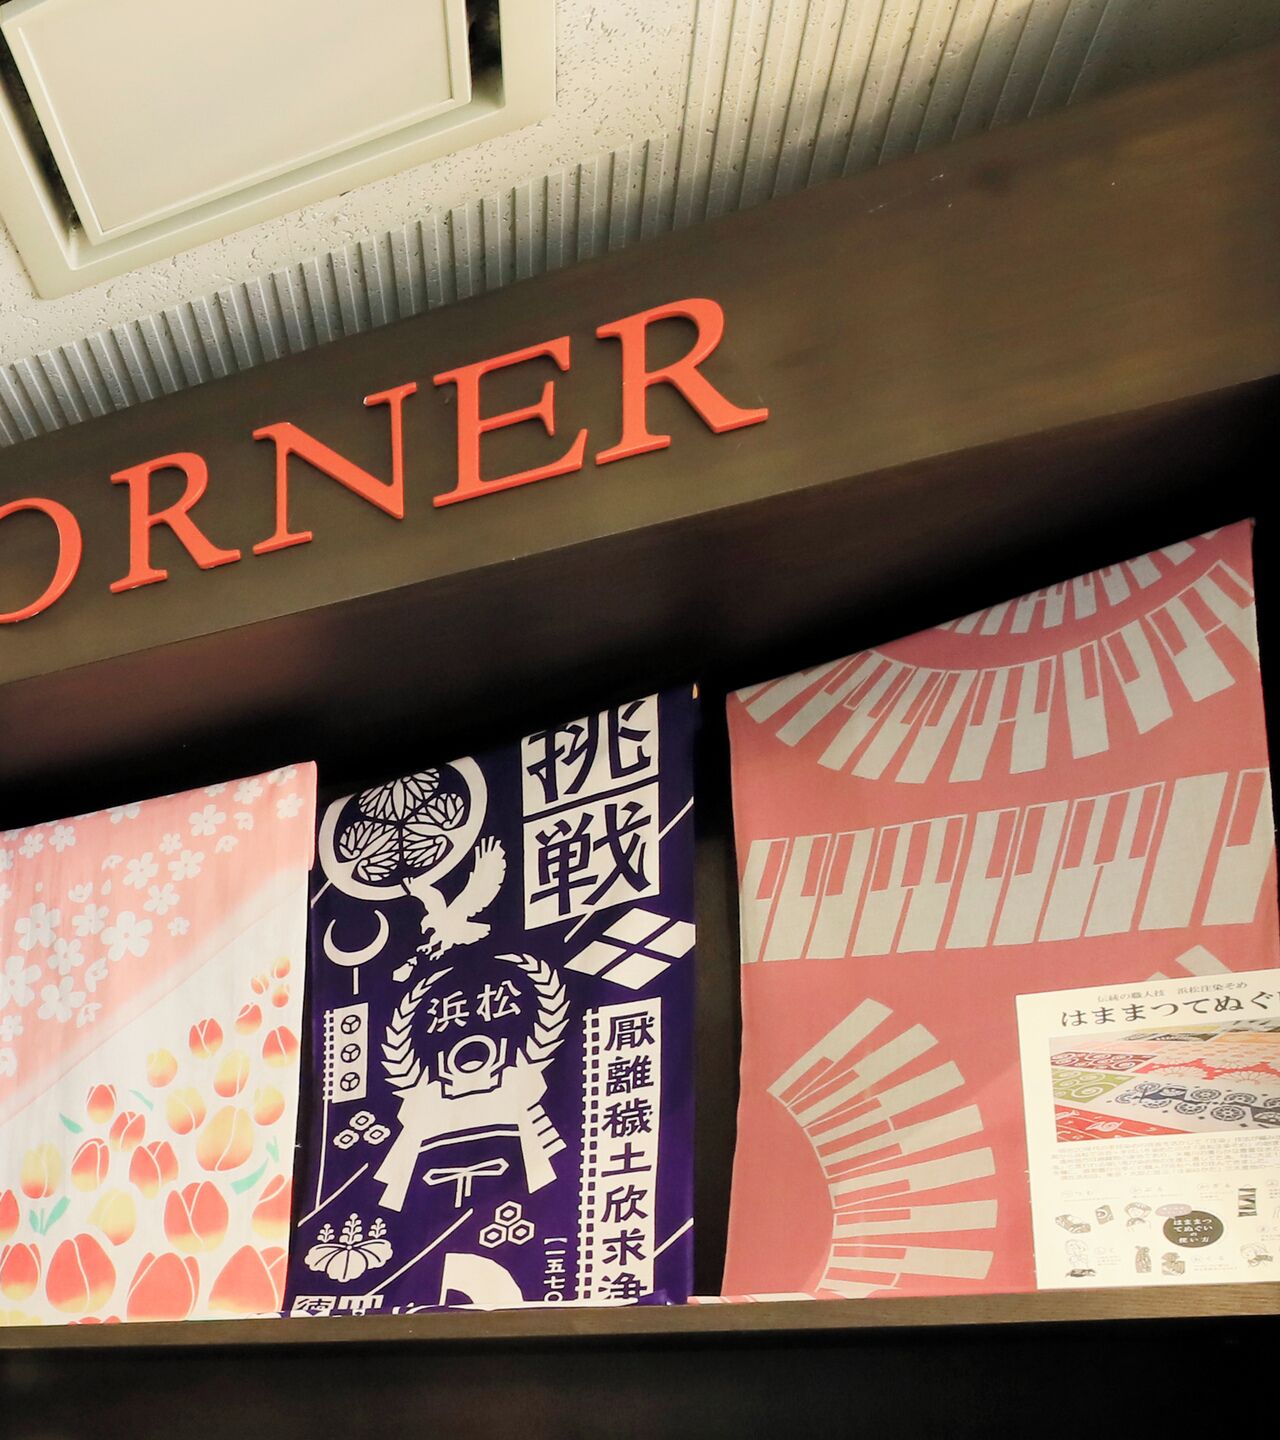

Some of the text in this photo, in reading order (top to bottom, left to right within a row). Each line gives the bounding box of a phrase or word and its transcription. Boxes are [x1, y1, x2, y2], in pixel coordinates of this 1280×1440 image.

[526, 697, 653, 915] 挑戦
[426, 982, 521, 1036] 浜松
[1061, 990, 1280, 1028] はままつてぬぐ
